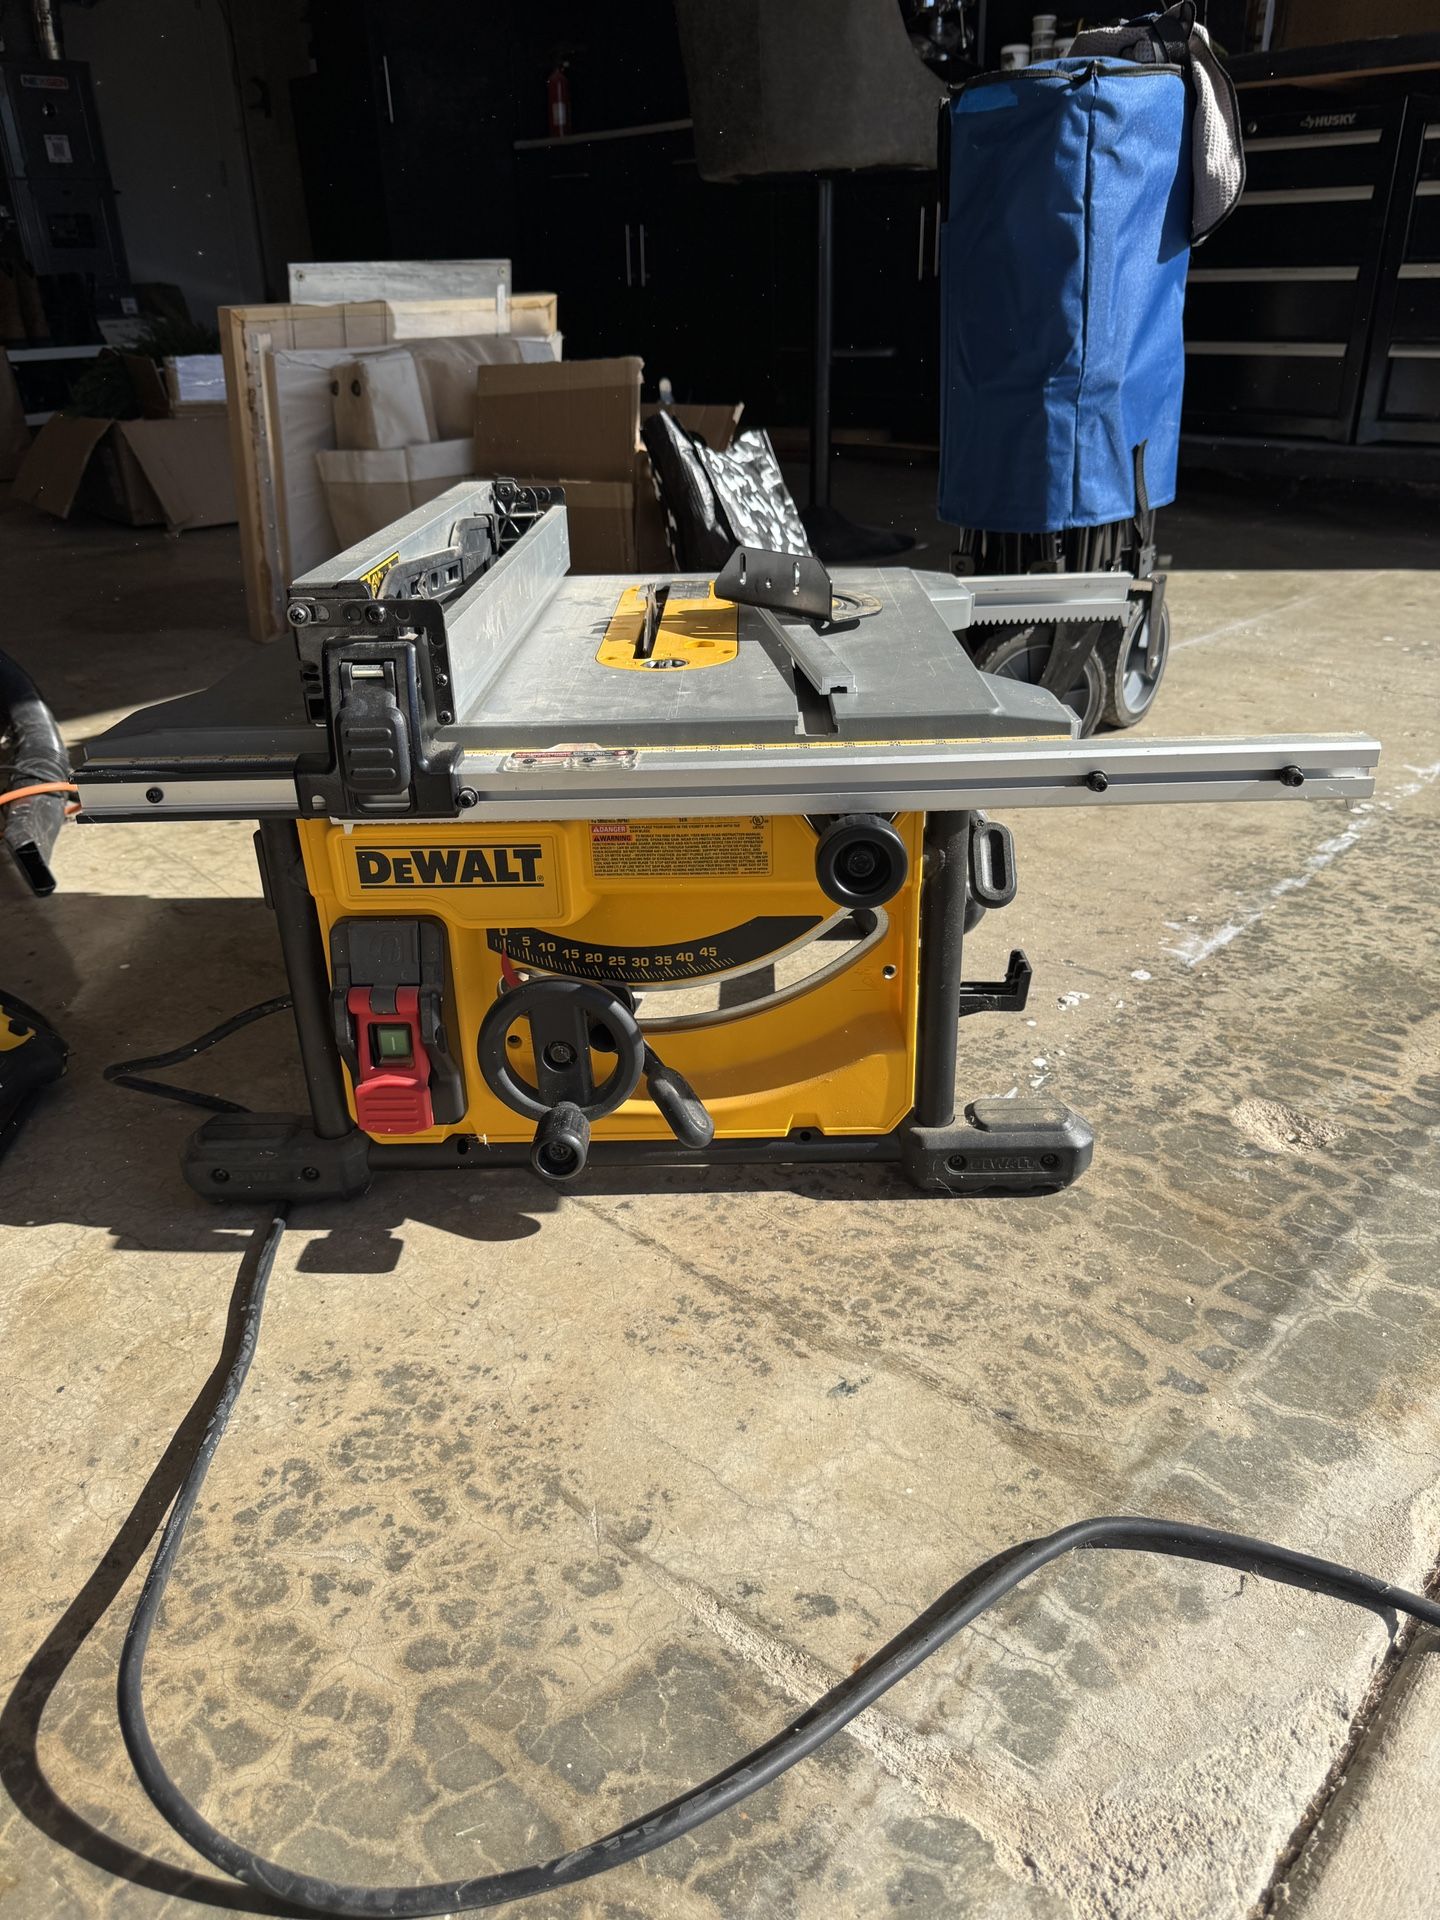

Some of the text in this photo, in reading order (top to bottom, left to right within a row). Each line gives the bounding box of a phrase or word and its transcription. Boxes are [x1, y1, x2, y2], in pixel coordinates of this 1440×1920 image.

[1315, 113, 1356, 127] HUSKY
[600, 834, 631, 842] WARNING
[499, 928, 717, 967] 0 5 10 15 20 25 30 35 40 45
